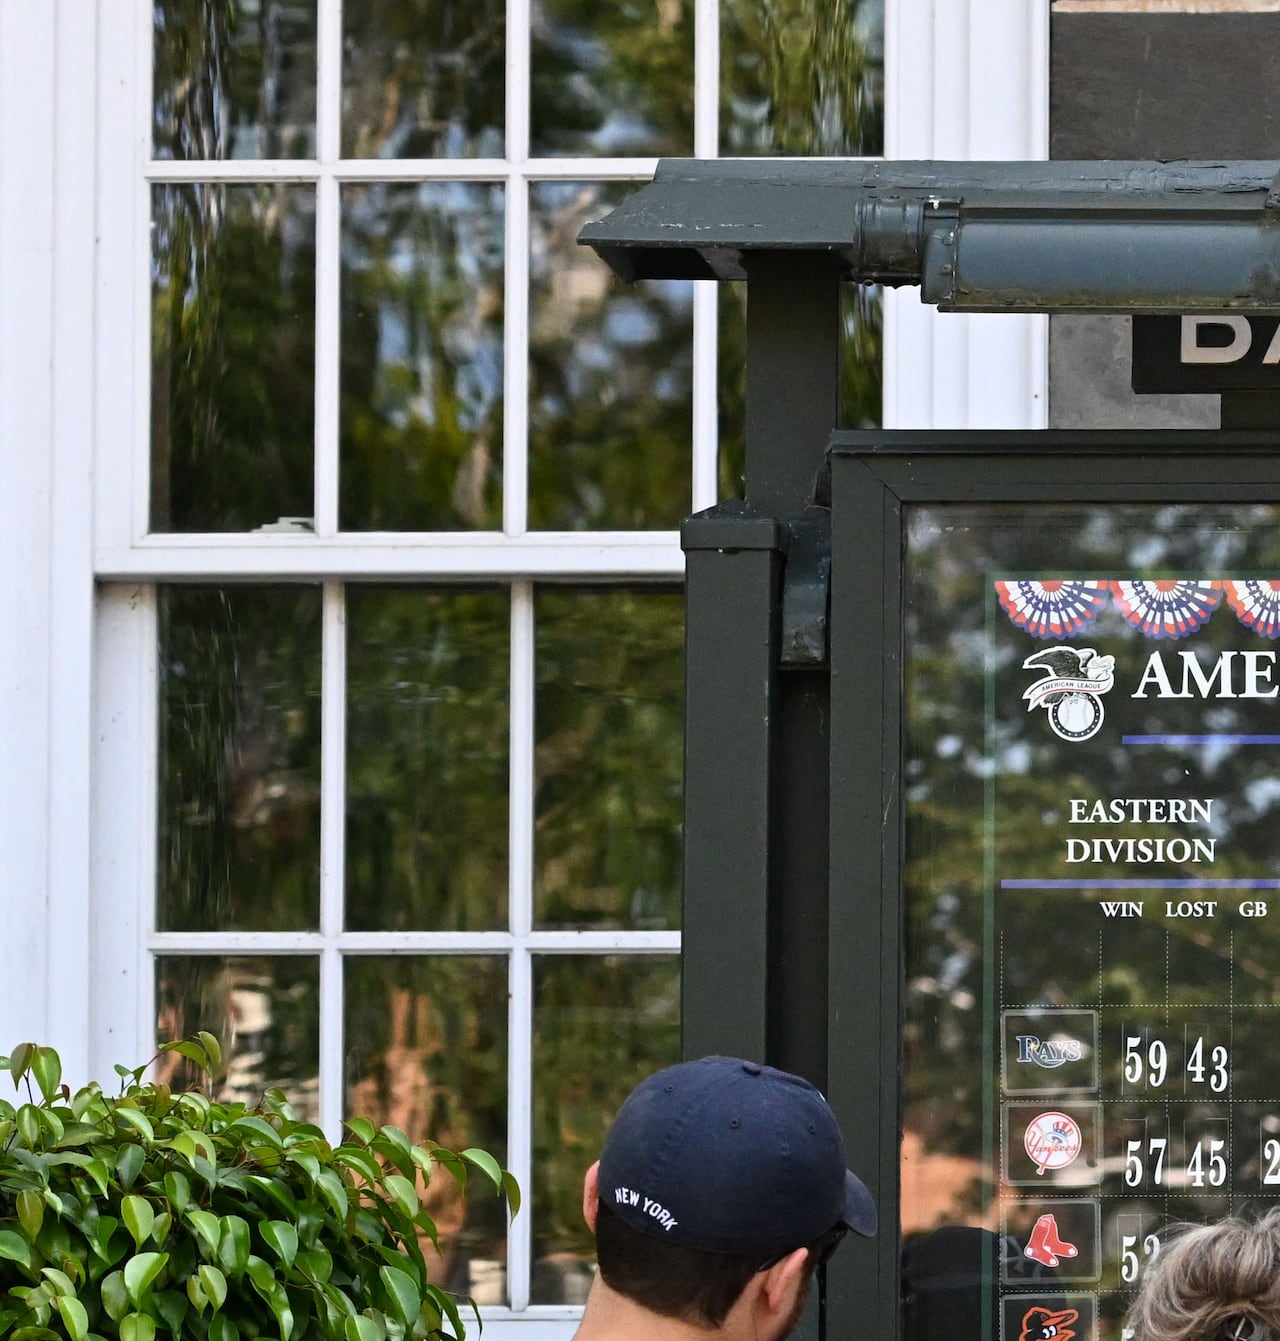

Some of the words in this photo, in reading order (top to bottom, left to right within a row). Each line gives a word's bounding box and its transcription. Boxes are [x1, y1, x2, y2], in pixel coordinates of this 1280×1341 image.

[1068, 798, 1214, 825] EASTERN
[1065, 838, 1217, 863] DIVISION
[1099, 901, 1144, 917] WIN
[1165, 901, 1218, 918] LOST
[1238, 901, 1268, 917] GB
[1124, 1036, 1168, 1087] 59
[1187, 1036, 1228, 1093] 43
[1027, 1131, 1079, 1159] Yankees
[1125, 1138, 1166, 1186] 57
[1187, 1140, 1227, 1187] 45
[614, 1186, 640, 1207] NEW
[643, 1197, 679, 1231] YORK
